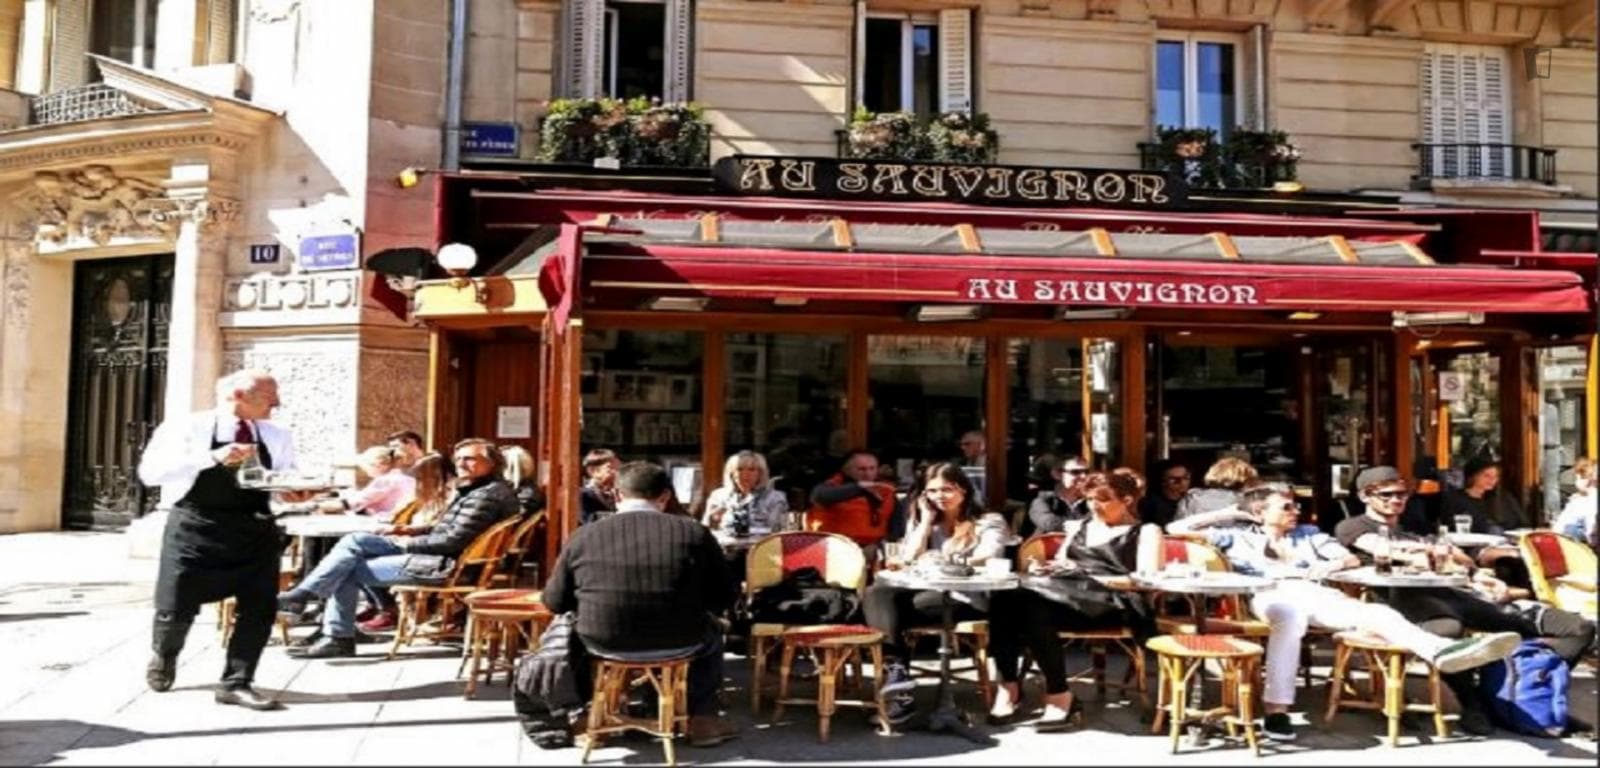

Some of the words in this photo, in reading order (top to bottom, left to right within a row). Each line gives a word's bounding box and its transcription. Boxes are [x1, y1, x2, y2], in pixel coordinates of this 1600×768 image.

[740, 159, 815, 191] AU
[836, 163, 1169, 203] SAUVIGNON
[255, 247, 275, 261] 10
[968, 278, 1018, 300] AU
[1034, 280, 1258, 304] SAUVIGNON
